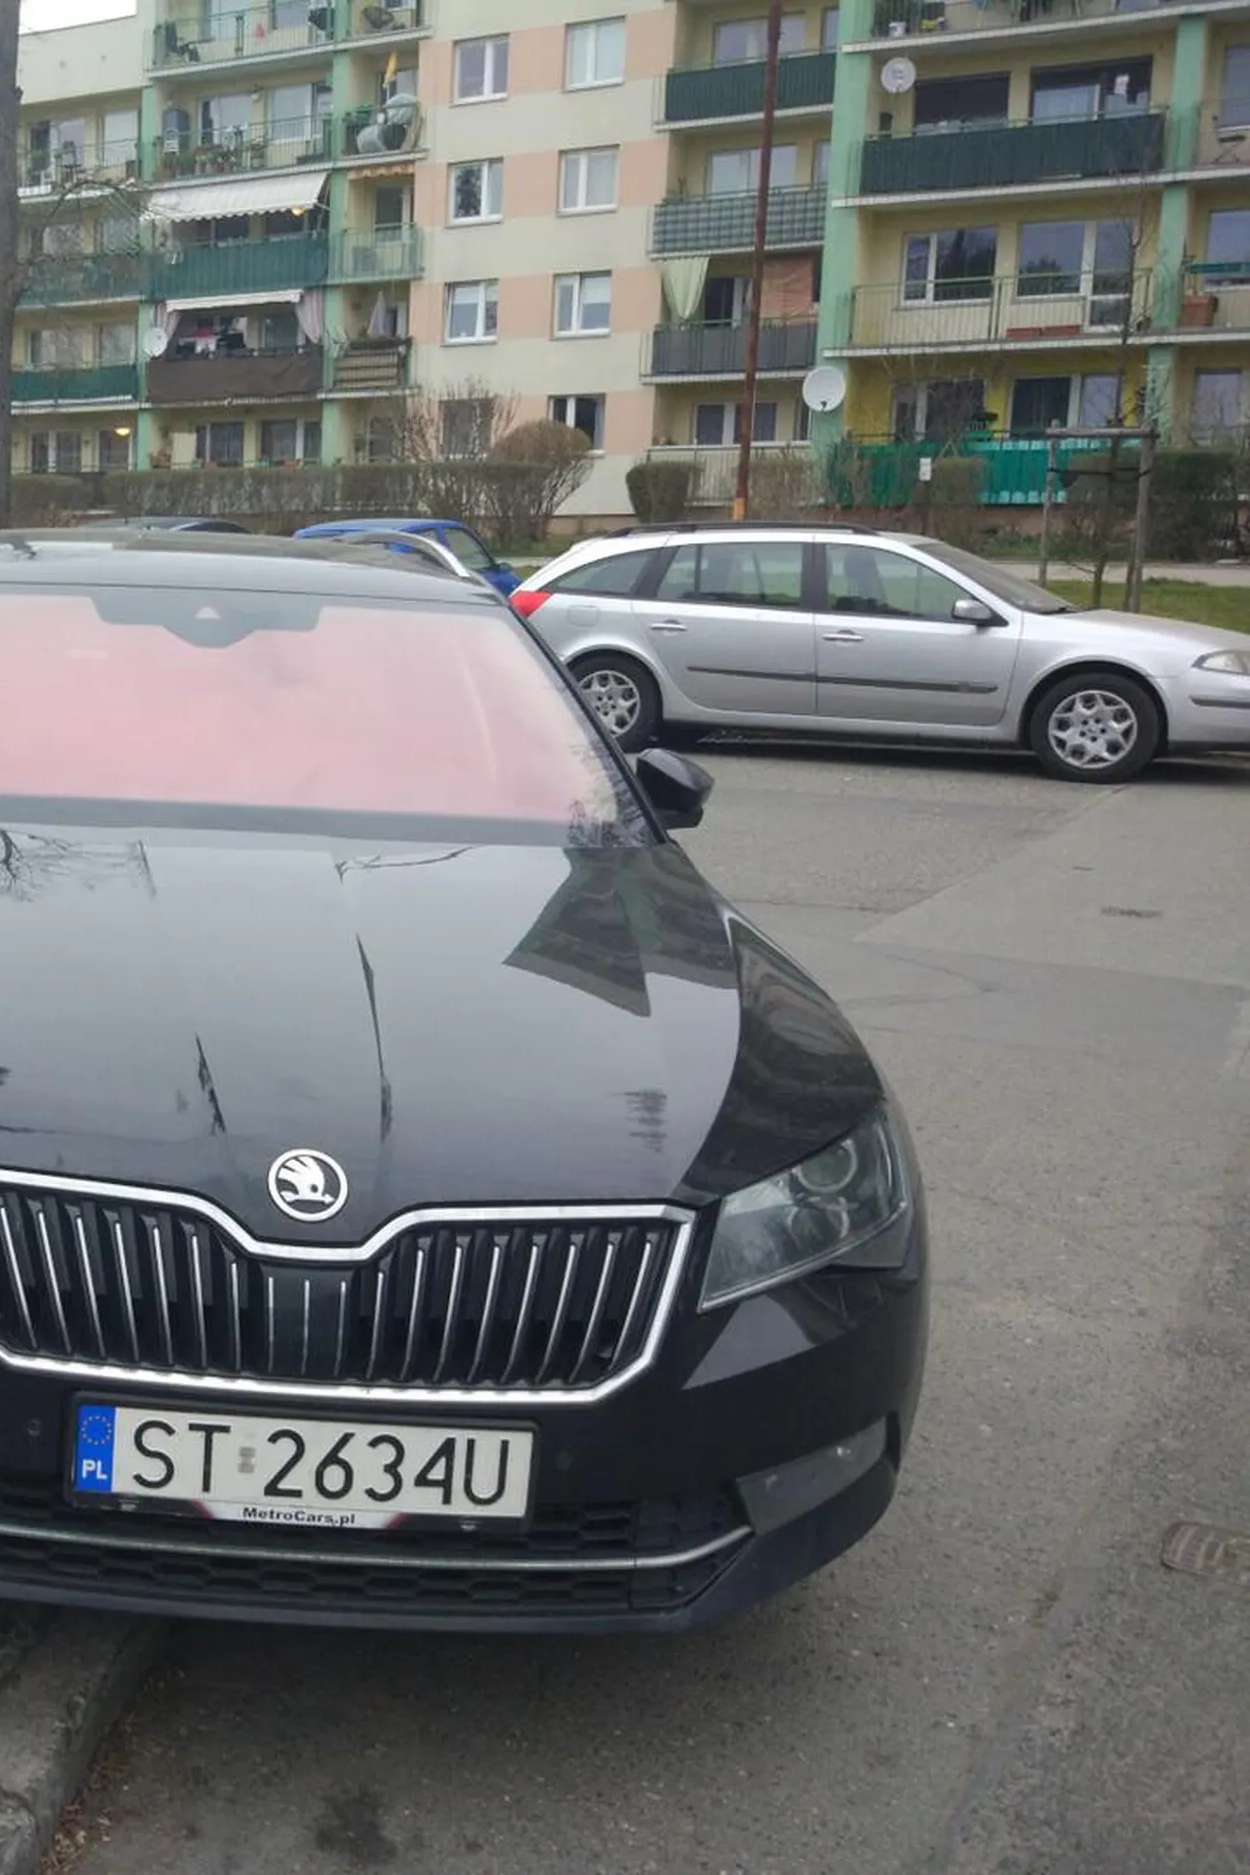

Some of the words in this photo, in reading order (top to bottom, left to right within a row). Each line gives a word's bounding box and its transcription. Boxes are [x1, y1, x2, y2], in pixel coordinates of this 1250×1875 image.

[81, 1459, 108, 1480] PL
[132, 1419, 231, 1493] ST
[263, 1428, 510, 1507] 2634U
[242, 1506, 356, 1526] MetroCars.pl
